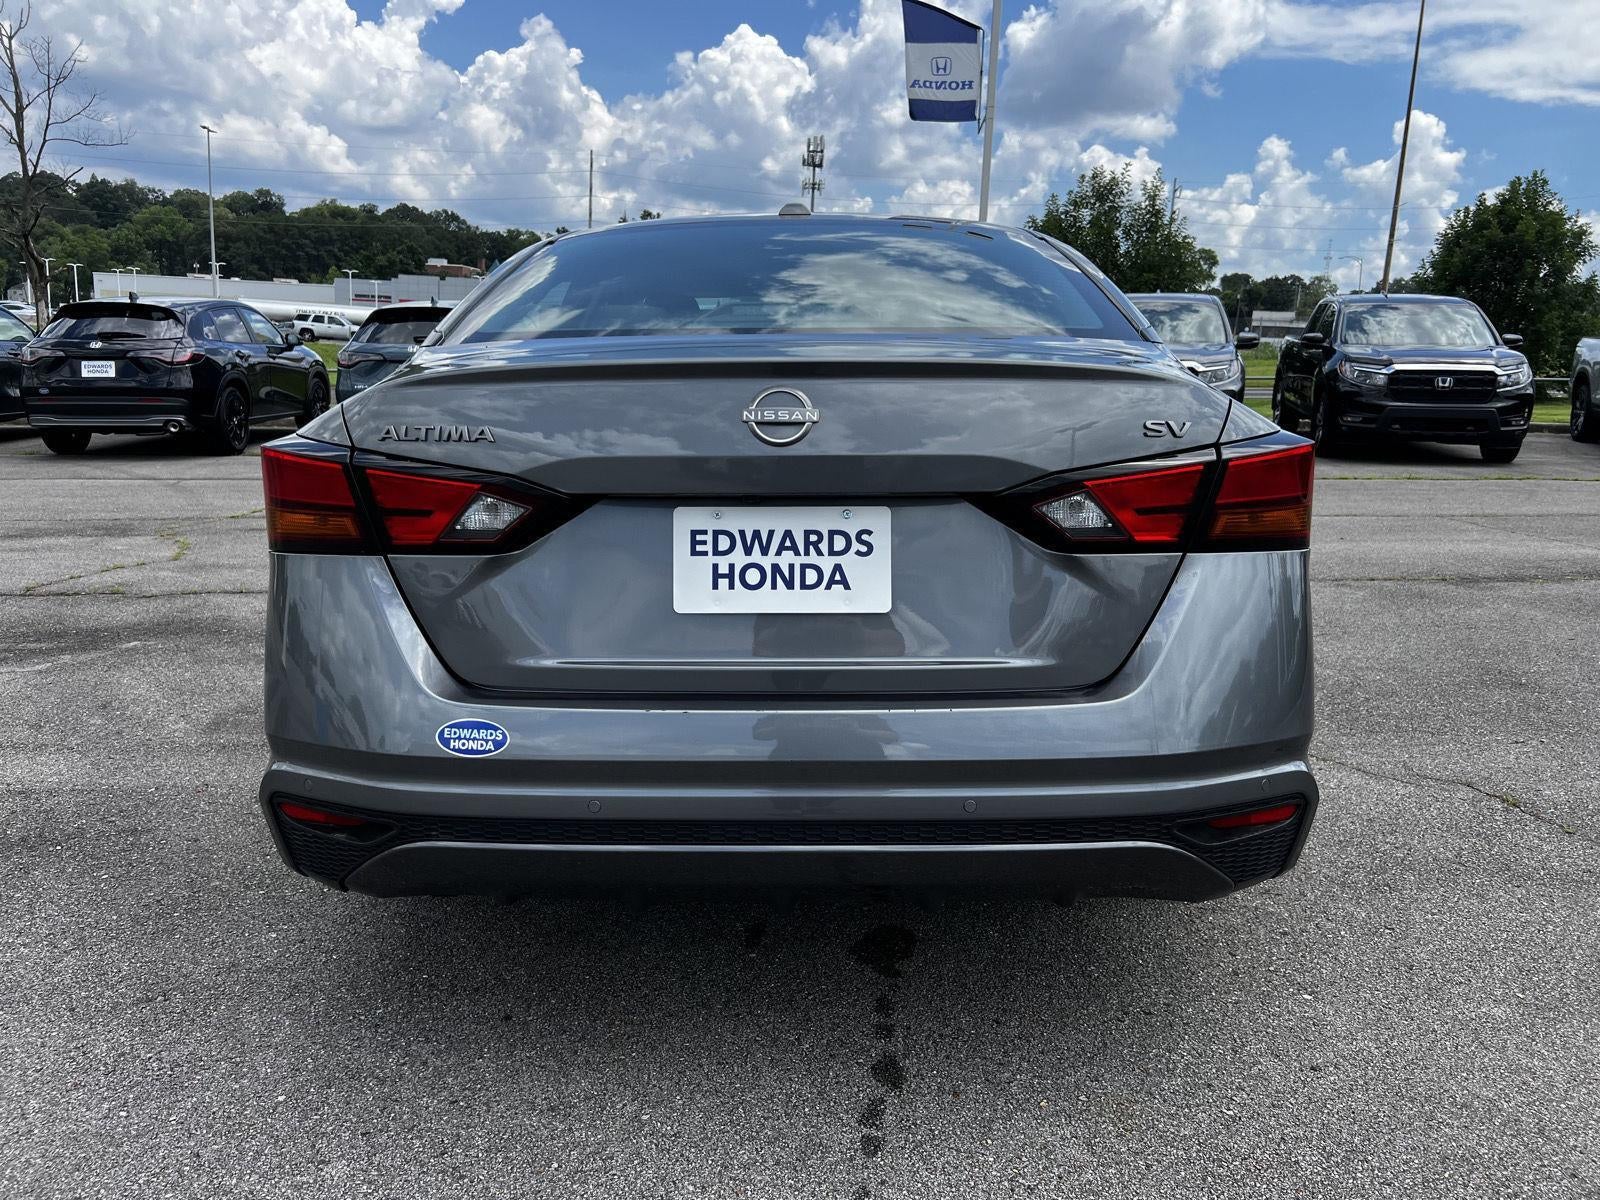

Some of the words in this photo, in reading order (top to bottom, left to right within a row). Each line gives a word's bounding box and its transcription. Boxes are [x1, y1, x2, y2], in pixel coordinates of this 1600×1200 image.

[743, 410, 817, 421] NISSAN
[378, 424, 496, 442] ALTIMA
[1143, 420, 1192, 438] SV
[690, 529, 874, 557] EDWARDS
[711, 562, 852, 591] HONDA
[443, 727, 503, 741] EDWARDS
[449, 739, 495, 751] HONDA
